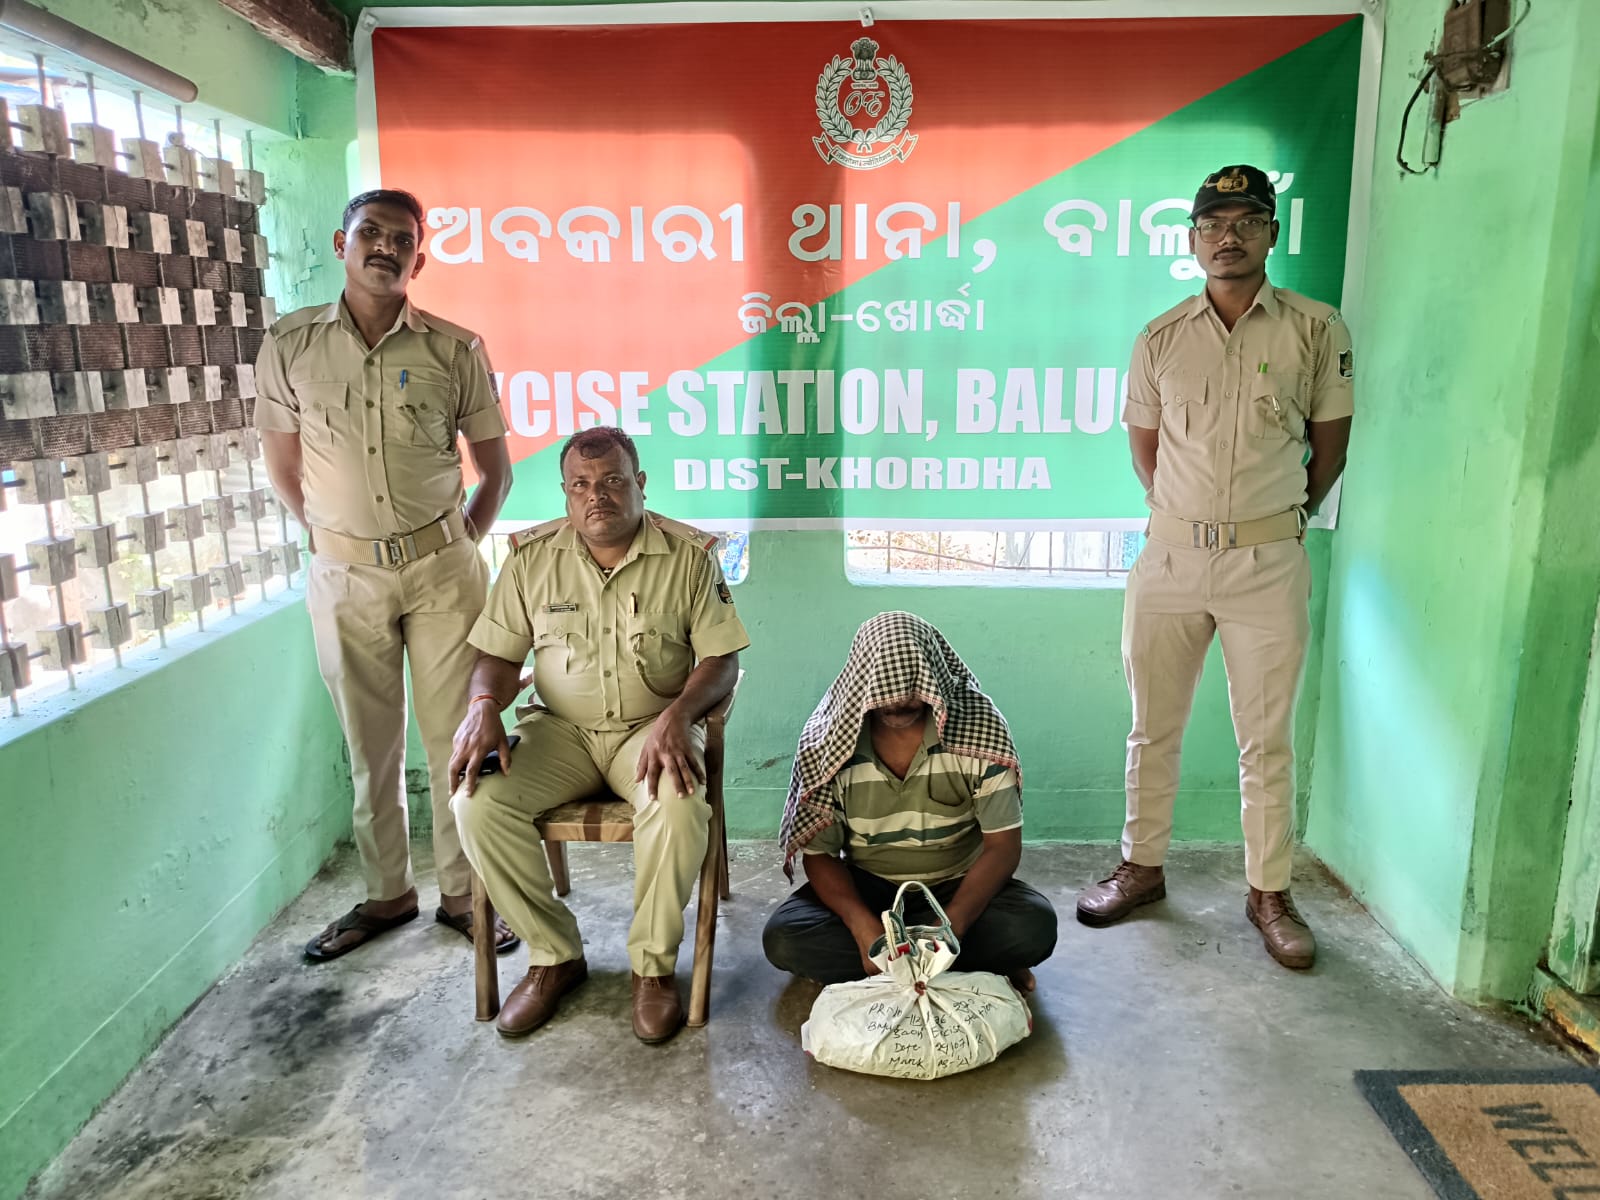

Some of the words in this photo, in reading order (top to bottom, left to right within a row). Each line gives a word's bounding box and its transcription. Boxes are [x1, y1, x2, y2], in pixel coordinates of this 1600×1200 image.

[426, 203, 743, 264] ଅବକାରୀ
[788, 201, 997, 274] ଥାନା,
[495, 369, 652, 437] CISE
[666, 367, 938, 442] STATION,
[956, 367, 1129, 435] BALU
[673, 457, 1052, 491] DIST-KHORDHA
